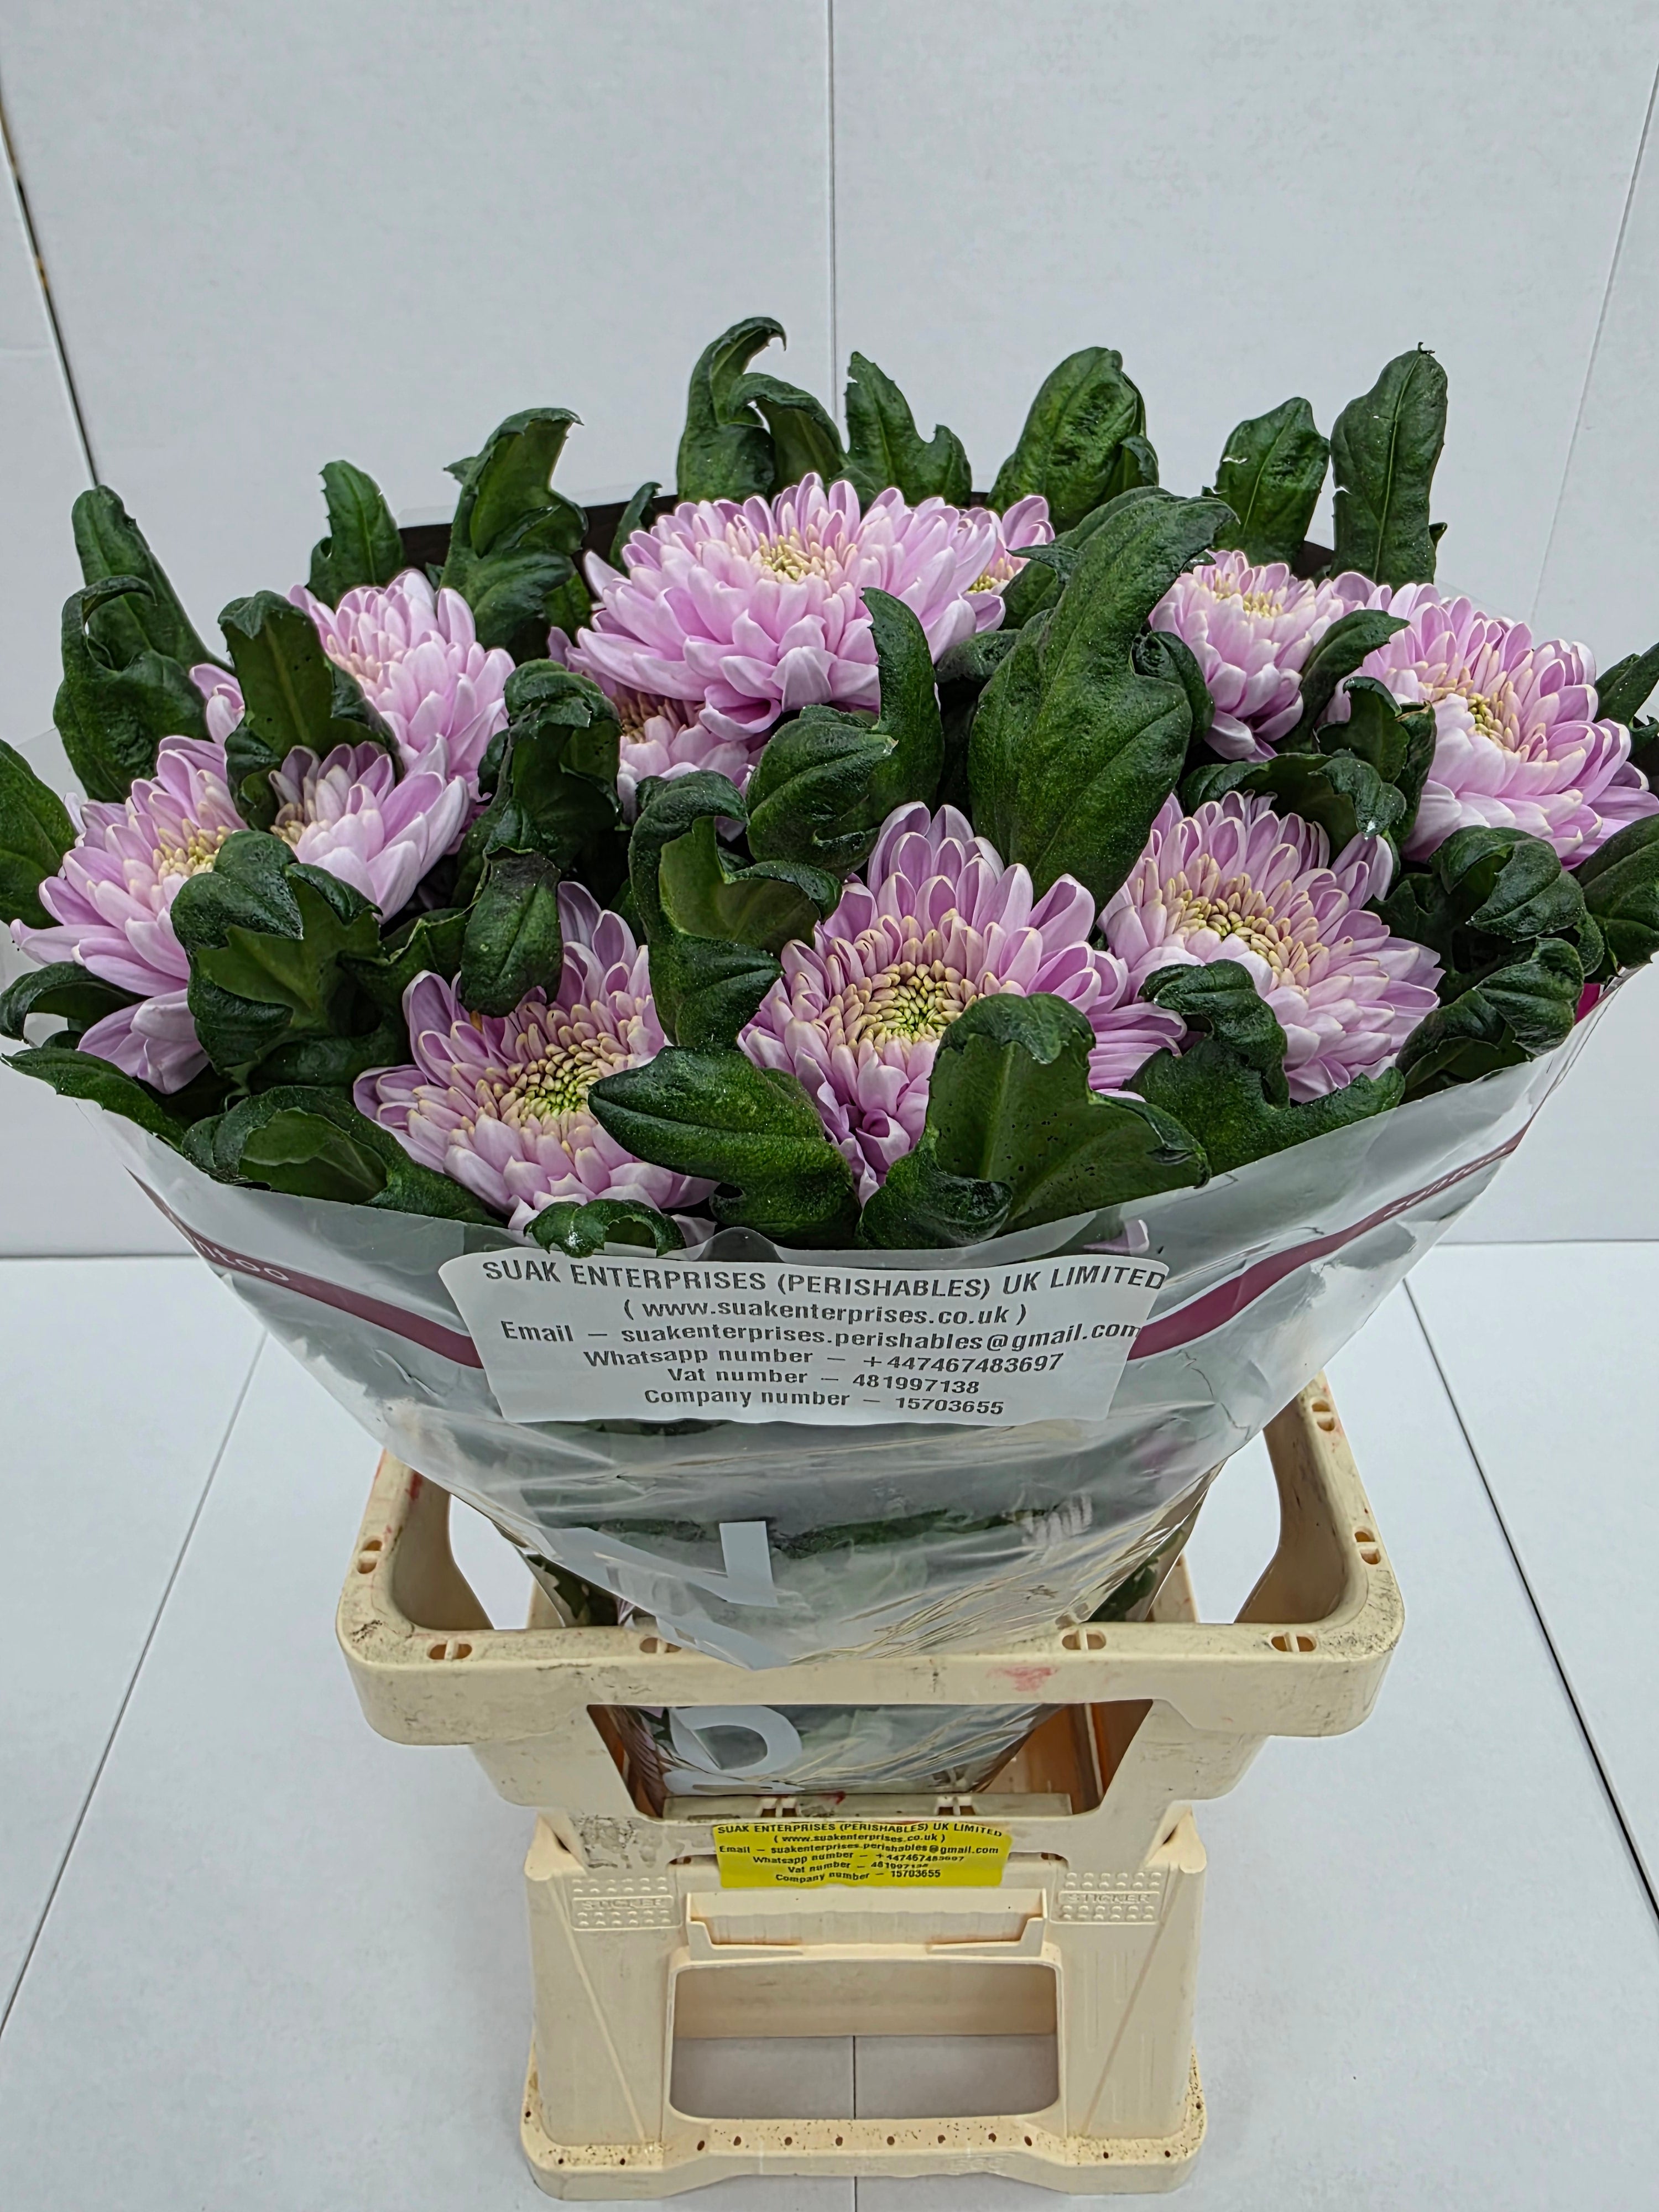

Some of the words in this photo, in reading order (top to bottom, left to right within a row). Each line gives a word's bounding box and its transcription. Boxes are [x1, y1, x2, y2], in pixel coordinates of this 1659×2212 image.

[483, 1260, 561, 1282] SUAK
[571, 1265, 765, 1290] ENTERPRISES
[778, 1274, 990, 1300] (PERISHABLES)
[1003, 1271, 1041, 1294] UK
[1051, 1266, 1165, 1289] LIMITED
[642, 1301, 1009, 1324] www.suakenterprises.co.uk
[501, 1321, 573, 1342] Email
[622, 1321, 1140, 1352] suakenterprises.perishables@gmail.com
[583, 1350, 707, 1366] Whatsapp
[719, 1349, 813, 1363] number
[864, 1353, 1063, 1373] +447467483697
[667, 1368, 706, 1381] Vat
[716, 1369, 807, 1383] number
[853, 1374, 979, 1394] 481997138
[645, 1390, 751, 1407] Company
[761, 1391, 849, 1405] number
[896, 1397, 1004, 1415] 15703655
[717, 1825, 749, 1834] SUAK
[754, 1824, 836, 1833] ENTERPRISES
[839, 1823, 928, 1833] (PERISHABLES)
[933, 1823, 949, 1831] UK
[954, 1823, 1002, 1837] LIMITED
[753, 1855, 808, 1864] Whatsapp
[811, 1852, 853, 1860] number
[809, 1862, 851, 1872] number
[775, 1872, 825, 1884] Company
[828, 1872, 870, 1881] number
[890, 1869, 941, 1878] 15703655
